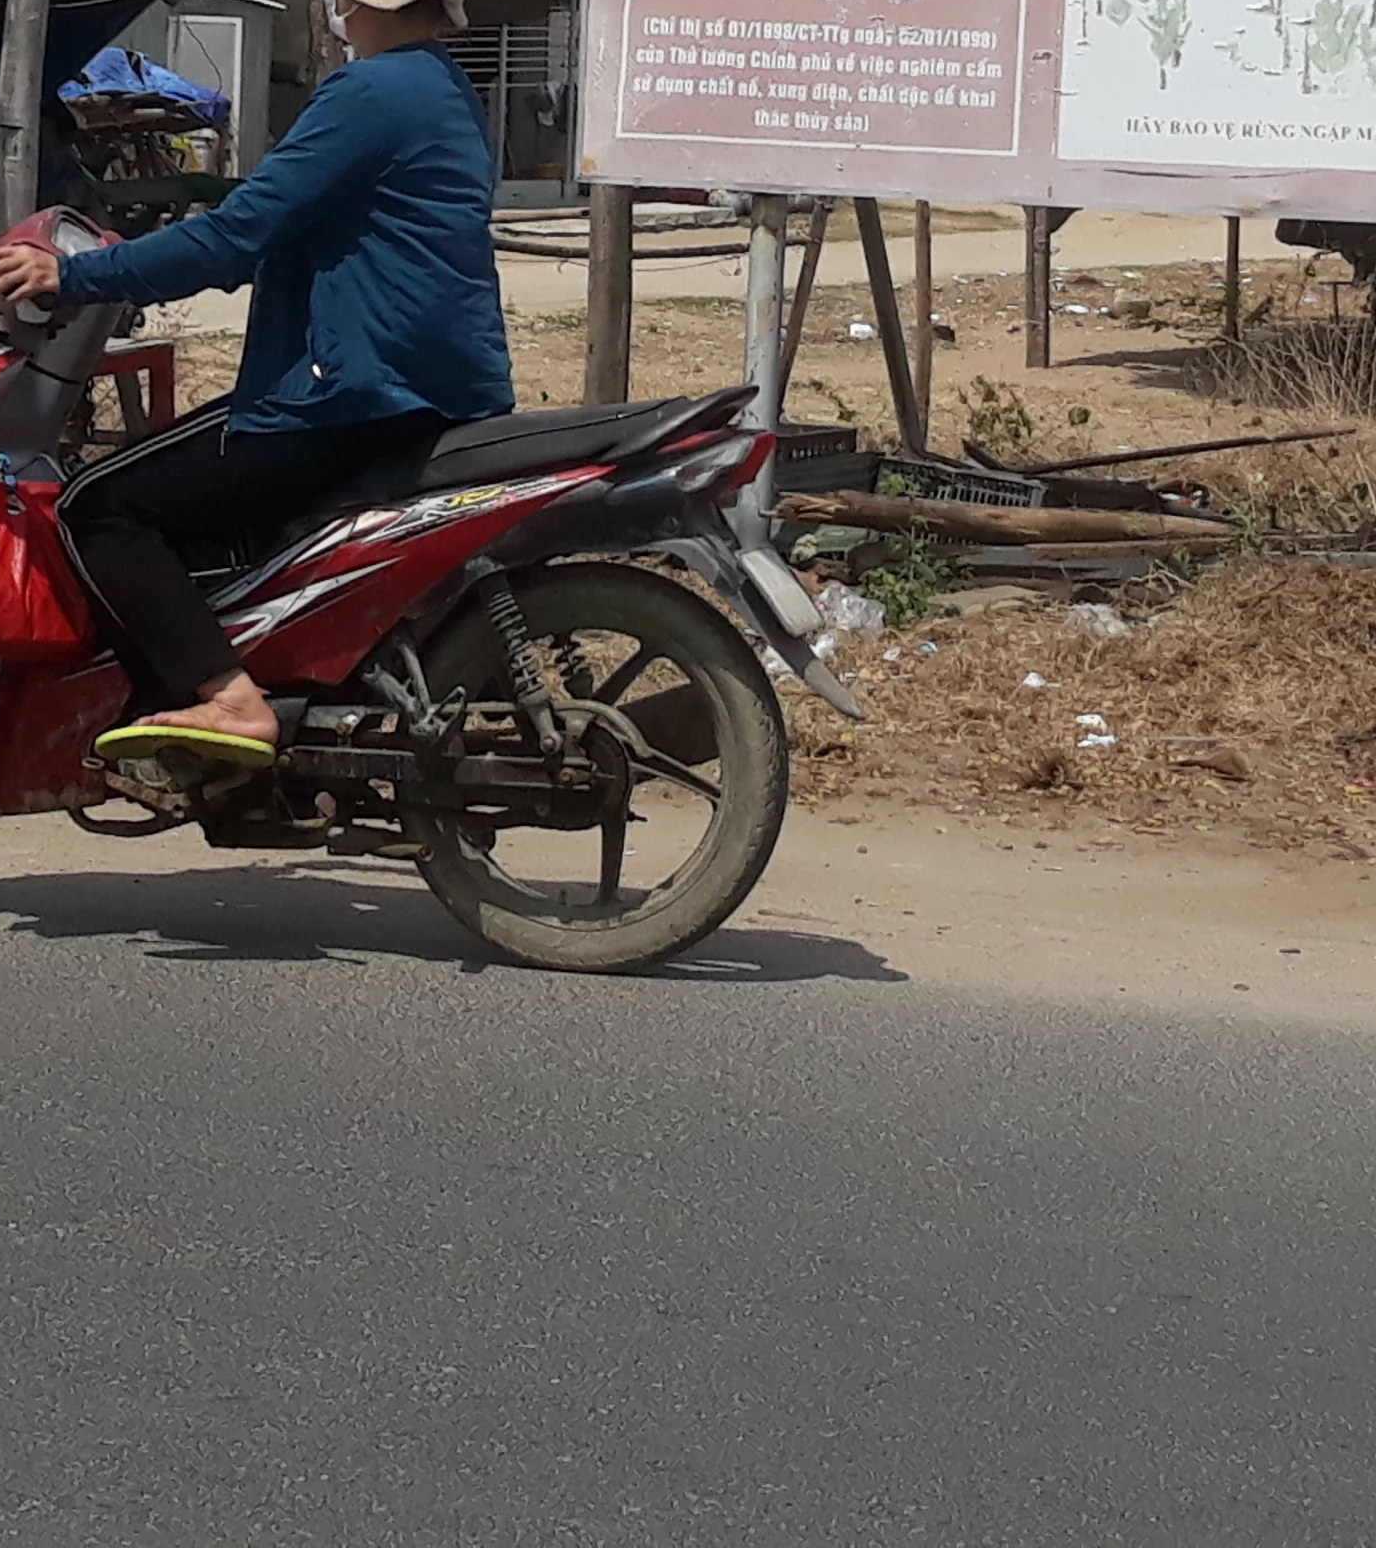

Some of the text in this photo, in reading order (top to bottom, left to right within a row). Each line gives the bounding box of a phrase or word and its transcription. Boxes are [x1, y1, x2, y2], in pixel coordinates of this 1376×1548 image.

[680, 17, 700, 39] thị
[705, 17, 725, 36] số
[635, 44, 664, 64] của
[750, 49, 796, 70] Chính
[801, 52, 831, 71] phủ
[836, 52, 855, 72] về
[860, 55, 894, 77] việc
[899, 58, 960, 77] nghiêm
[965, 57, 1002, 79] cấm
[655, 76, 694, 97] dụng
[698, 75, 734, 95] chất
[768, 82, 807, 102] xung
[858, 83, 894, 103] chất
[959, 89, 996, 108] khai
[754, 110, 789, 128] thác
